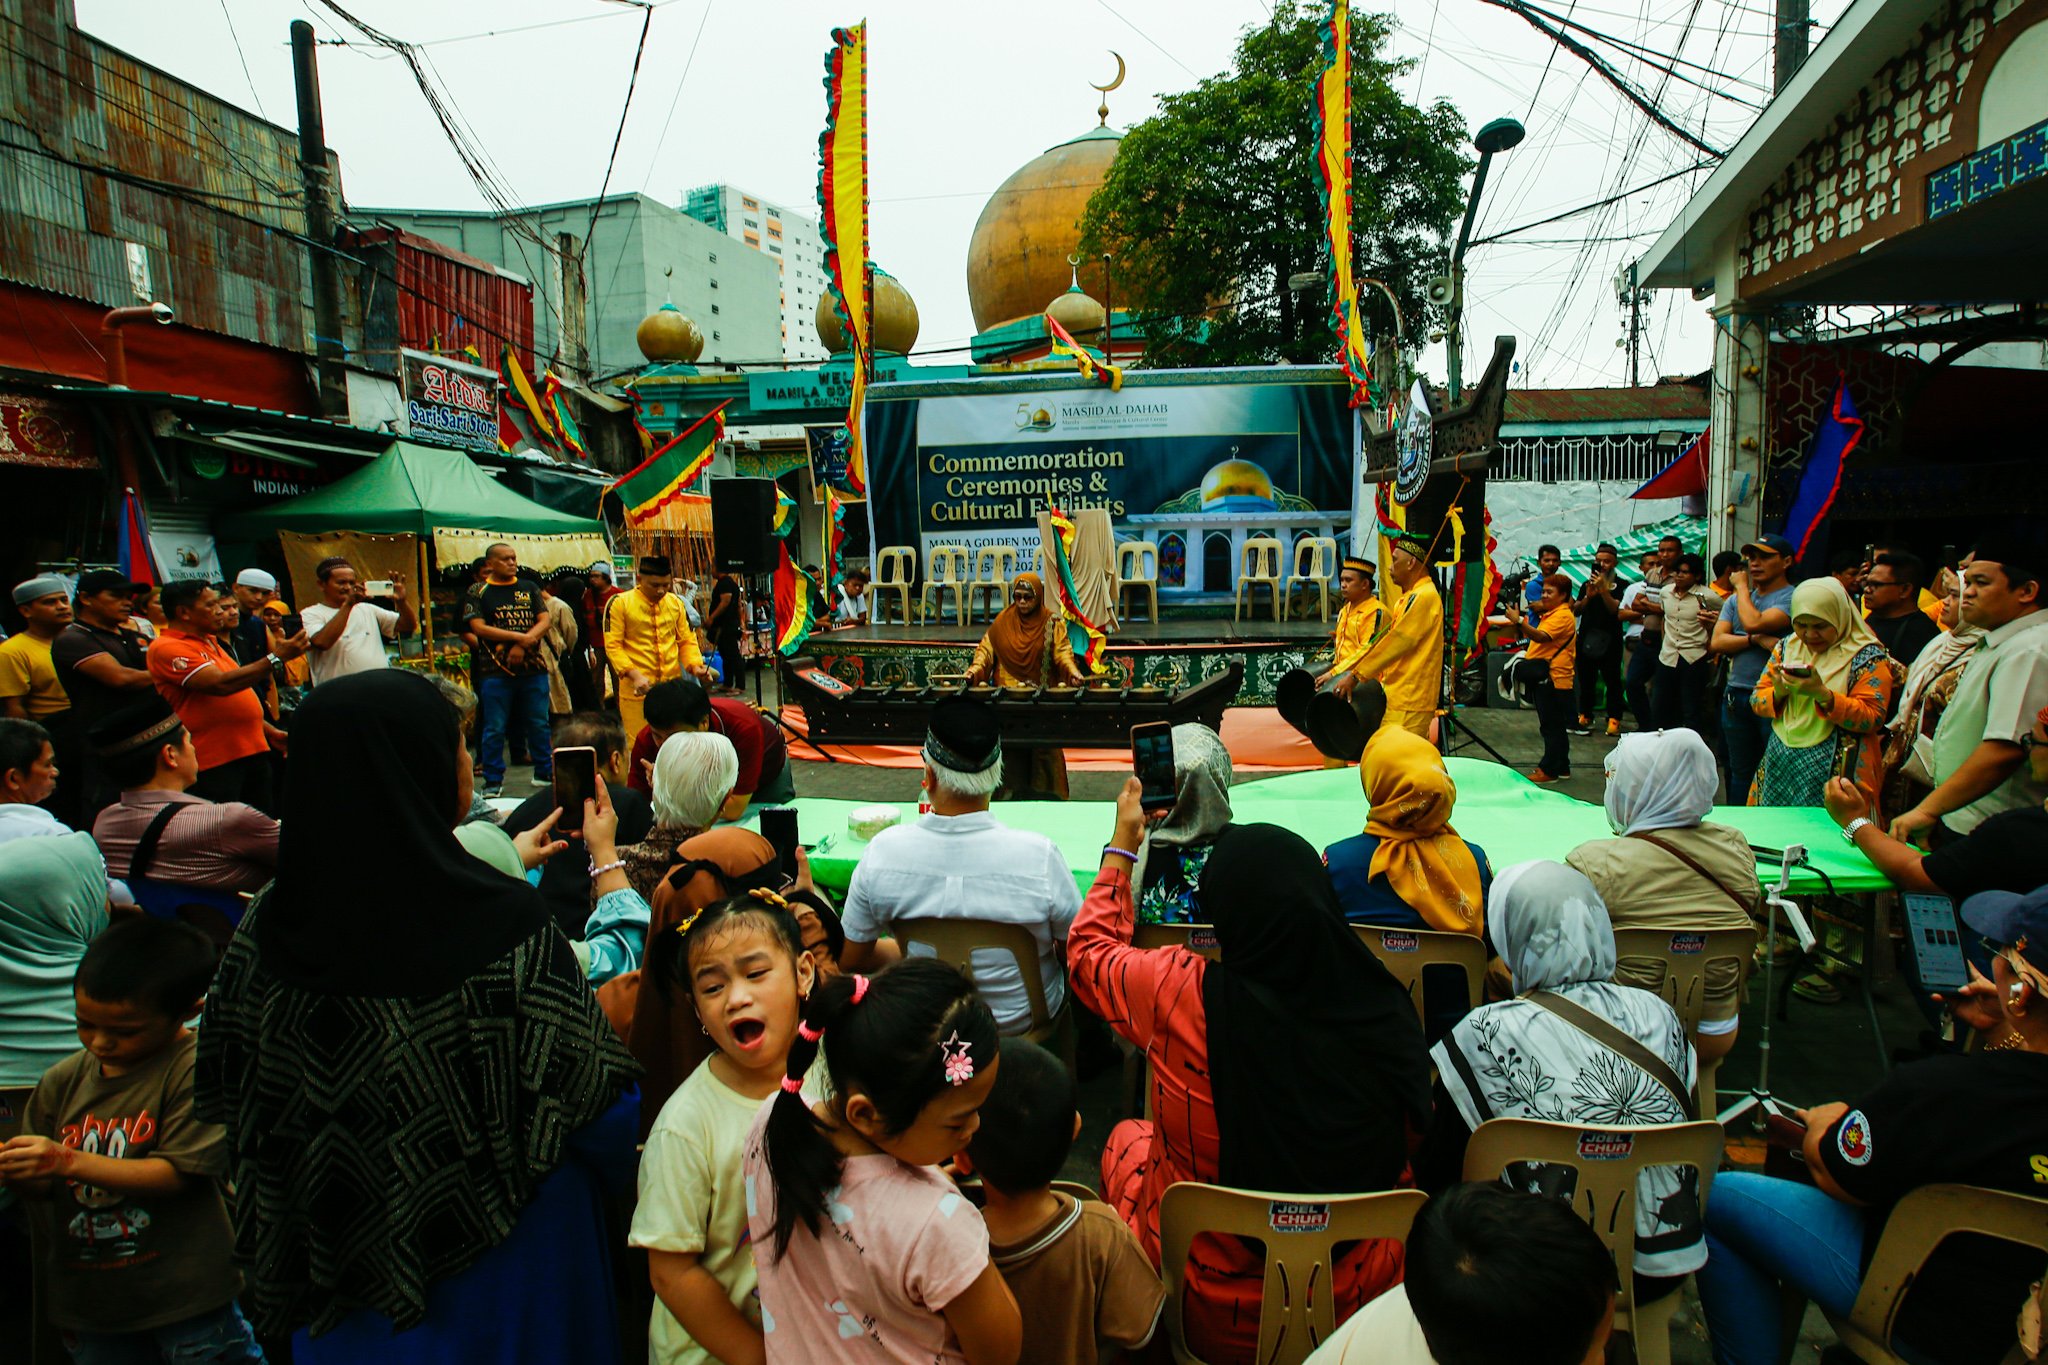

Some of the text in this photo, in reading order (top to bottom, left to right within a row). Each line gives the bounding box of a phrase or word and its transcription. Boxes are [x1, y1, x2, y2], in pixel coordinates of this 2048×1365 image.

[818, 369, 897, 385] WELME
[422, 364, 492, 417] Aida
[766, 386, 820, 400] MANILA
[813, 397, 850, 407] CULTU
[1062, 403, 1168, 418] MASJID AL-DAHAB
[470, 412, 498, 440] Store
[929, 446, 1125, 474] Commemoration
[253, 478, 299, 496] INDIAN
[946, 471, 1108, 498] Ceremonies &
[931, 497, 1023, 521] Cultural
[929, 538, 971, 549] MANILA
[974, 537, 1022, 548] GOLDEN
[1584, 1142, 1627, 1152] CHUA
[1277, 1204, 1318, 1214] JOEL
[1277, 1214, 1323, 1224] CHUA
